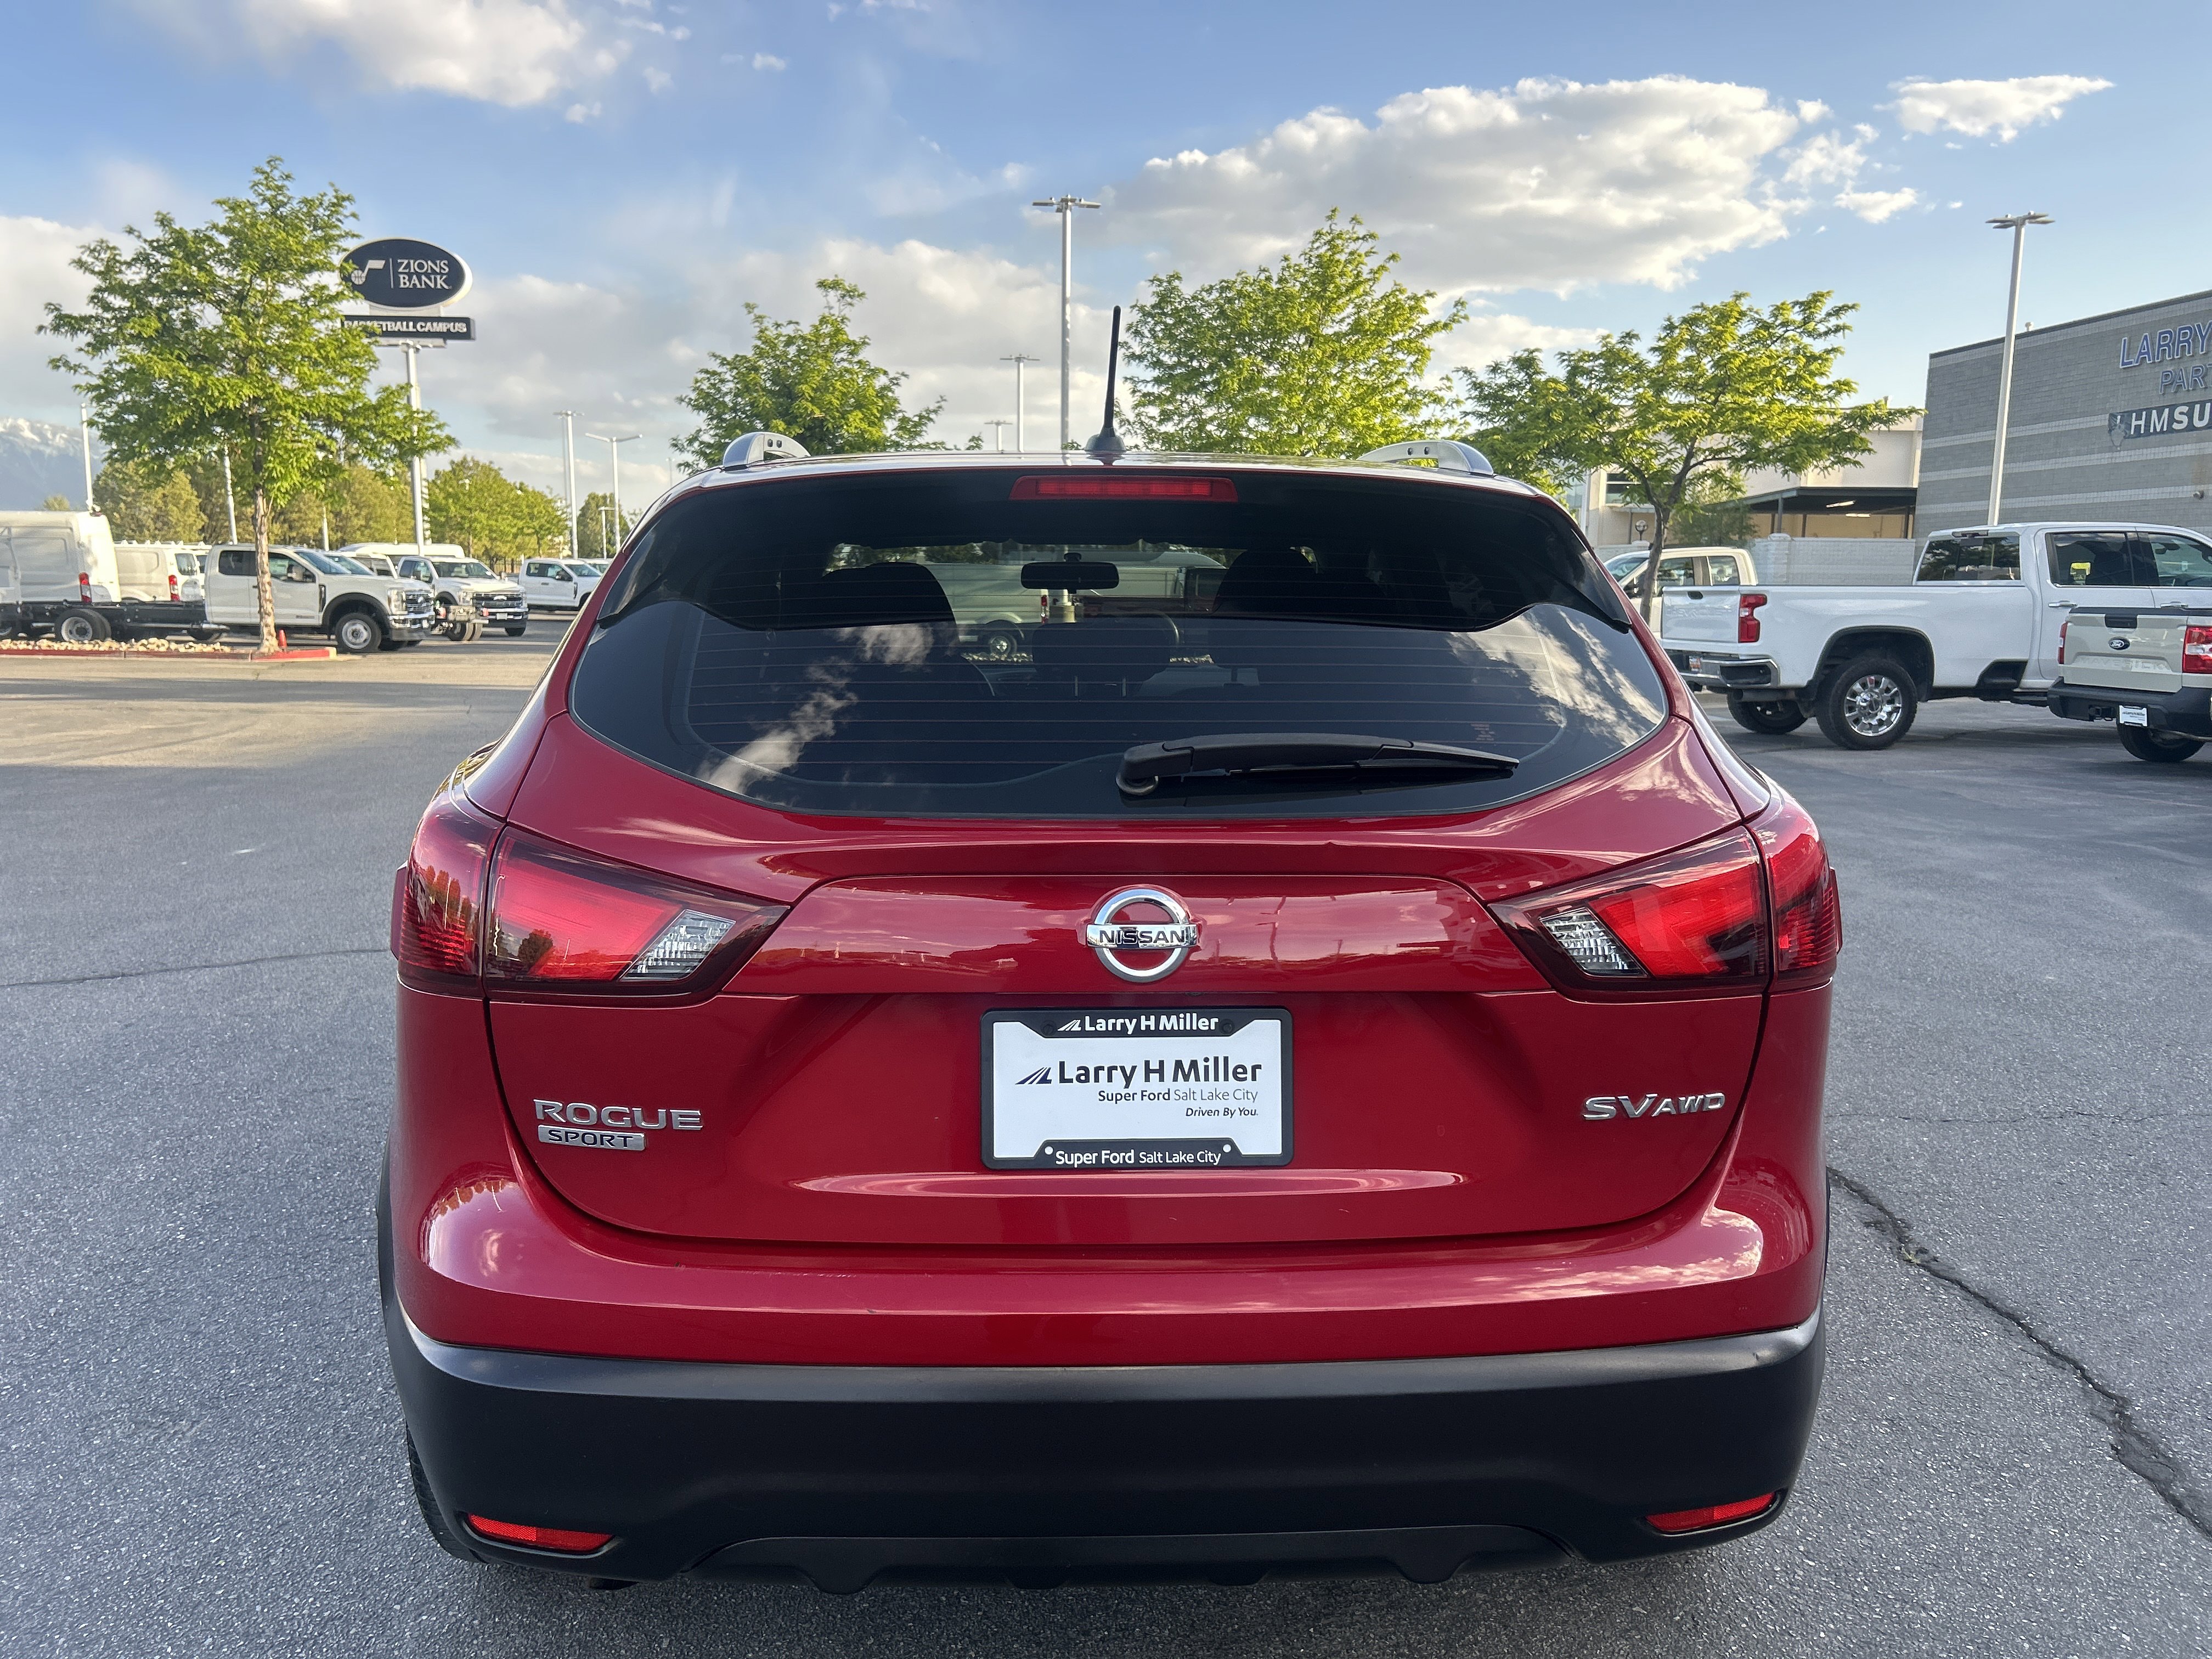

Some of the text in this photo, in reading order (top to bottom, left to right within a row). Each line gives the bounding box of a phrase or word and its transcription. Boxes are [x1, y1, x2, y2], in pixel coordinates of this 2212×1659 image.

[398, 259, 449, 273] ZIONS
[399, 274, 452, 289] BANK
[416, 322, 467, 333] CAMPUS
[2119, 320, 2212, 368] LARRY
[1099, 930, 1185, 944] NISSAN
[1085, 1013, 1218, 1035] Larry H Miller
[1059, 1056, 1262, 1089] Larry H Miller
[1098, 1087, 1259, 1104] Super Ford Salt Lake City
[533, 1099, 703, 1130] ROGUE
[1186, 1107, 1220, 1116] Driven
[1223, 1107, 1237, 1119] By
[548, 1130, 634, 1148] SPORT
[1056, 1149, 1222, 1168] Super Ford Salt Lake City
